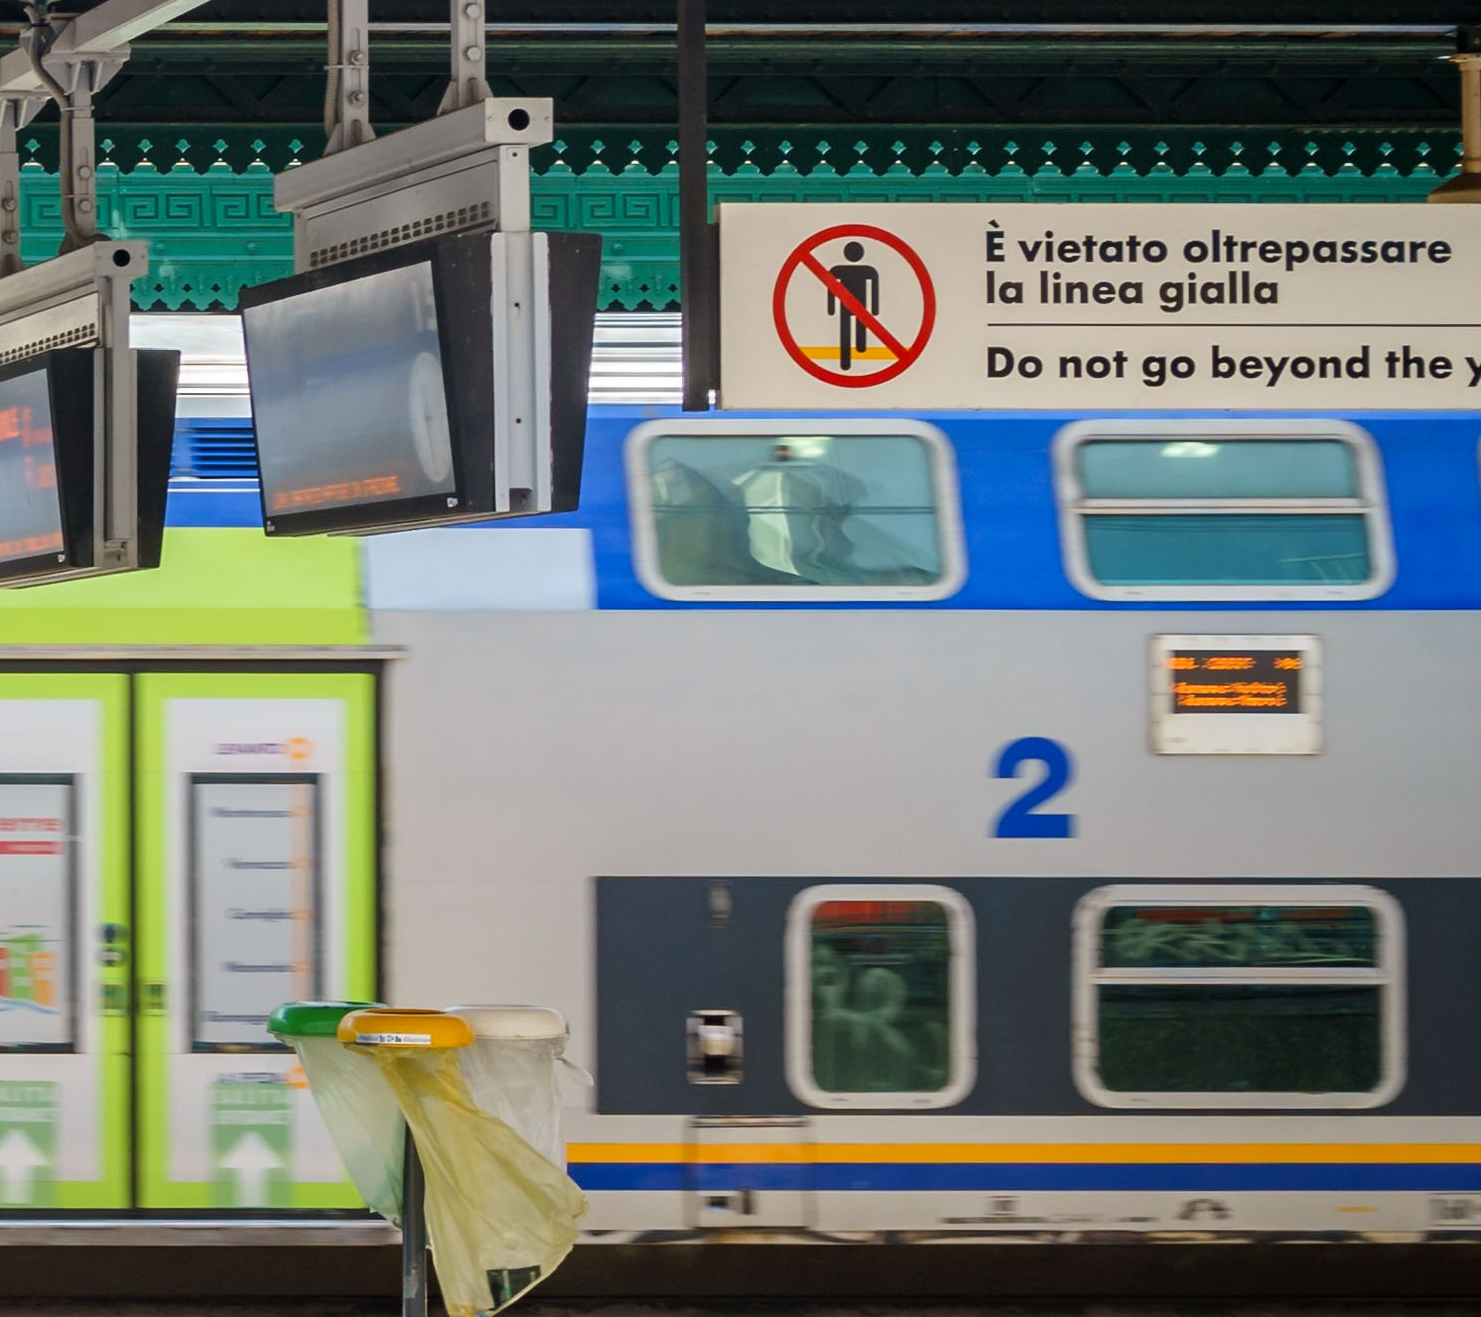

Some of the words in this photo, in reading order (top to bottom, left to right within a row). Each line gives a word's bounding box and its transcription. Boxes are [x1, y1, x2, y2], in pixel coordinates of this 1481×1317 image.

[985, 219, 1006, 263] È
[1017, 230, 1169, 264] vietato
[1182, 230, 1453, 272] oltrepassare
[986, 270, 1024, 304] la
[1040, 270, 1144, 305] linea
[1158, 270, 1279, 313] gialla
[986, 346, 1044, 379] Do
[1058, 350, 1129, 379] not
[1141, 356, 1197, 388] go
[1211, 345, 1371, 388] beyond
[1385, 345, 1454, 379] the
[991, 736, 1077, 839] 2
